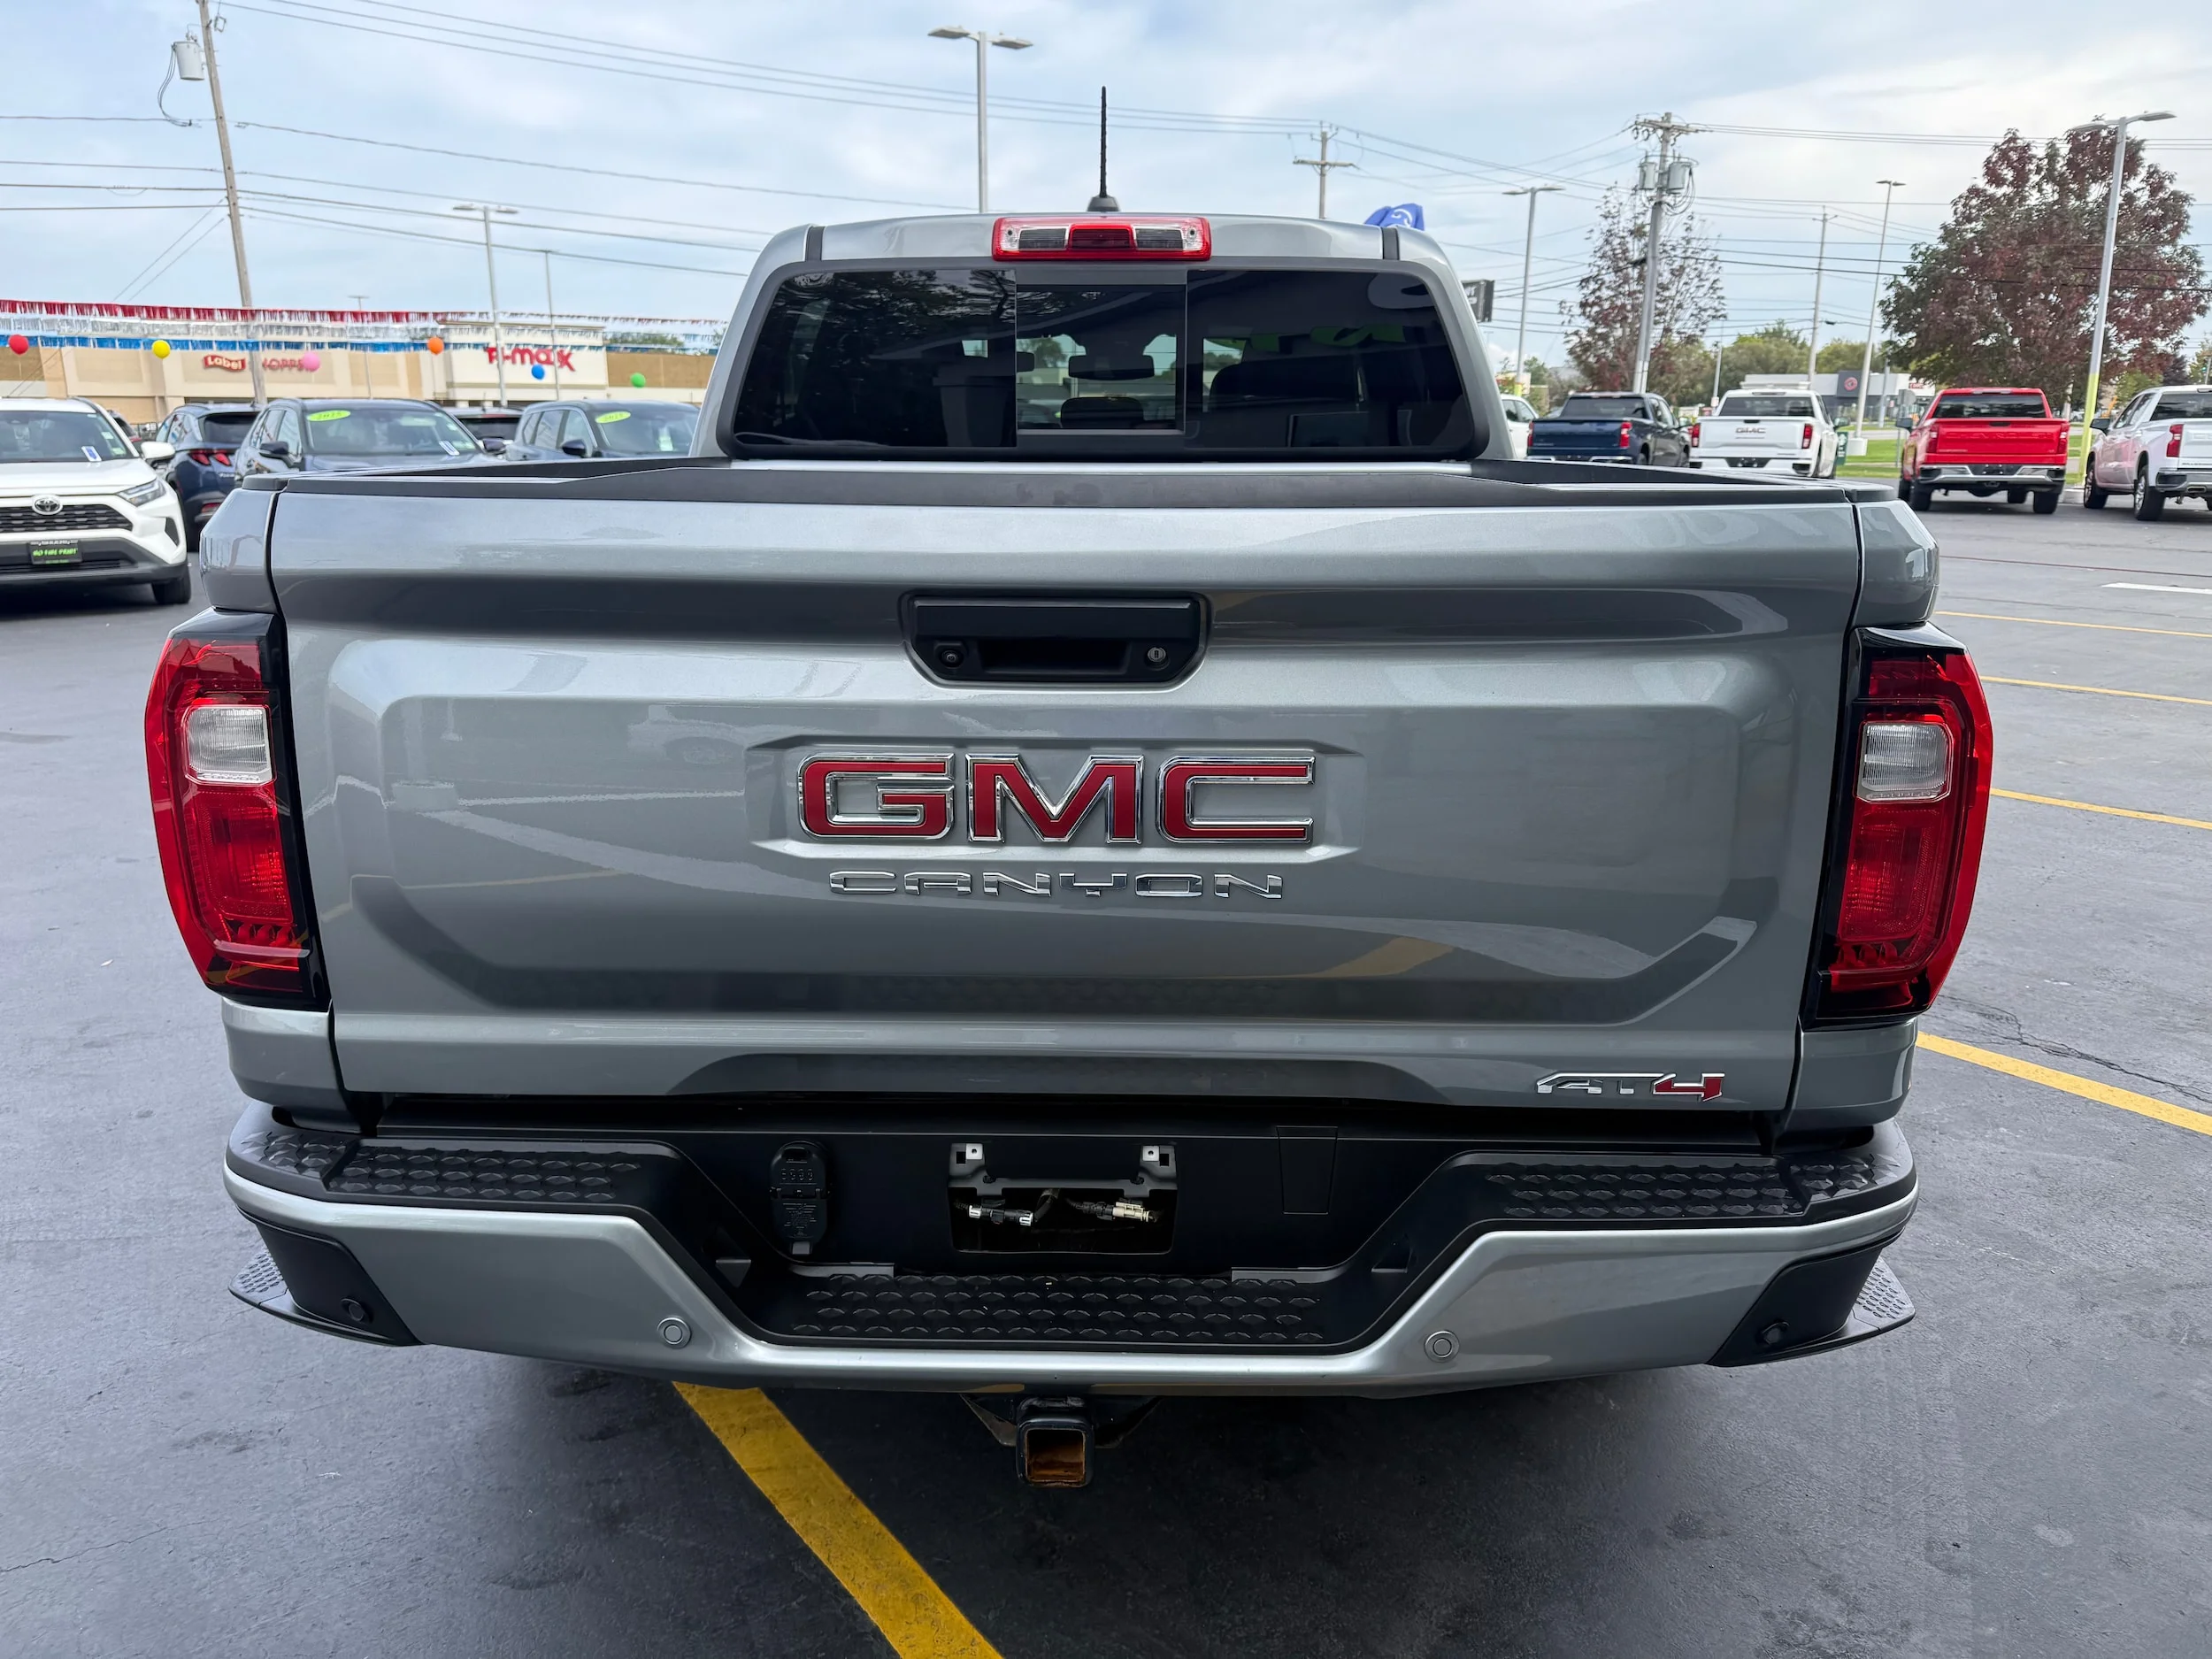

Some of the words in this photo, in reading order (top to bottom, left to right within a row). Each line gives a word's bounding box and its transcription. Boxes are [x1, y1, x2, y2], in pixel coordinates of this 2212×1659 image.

[207, 356, 242, 370] Label
[798, 754, 1315, 844] GMC
[829, 871, 1283, 900] CANYON
[1536, 1072, 1725, 1102] AT4
